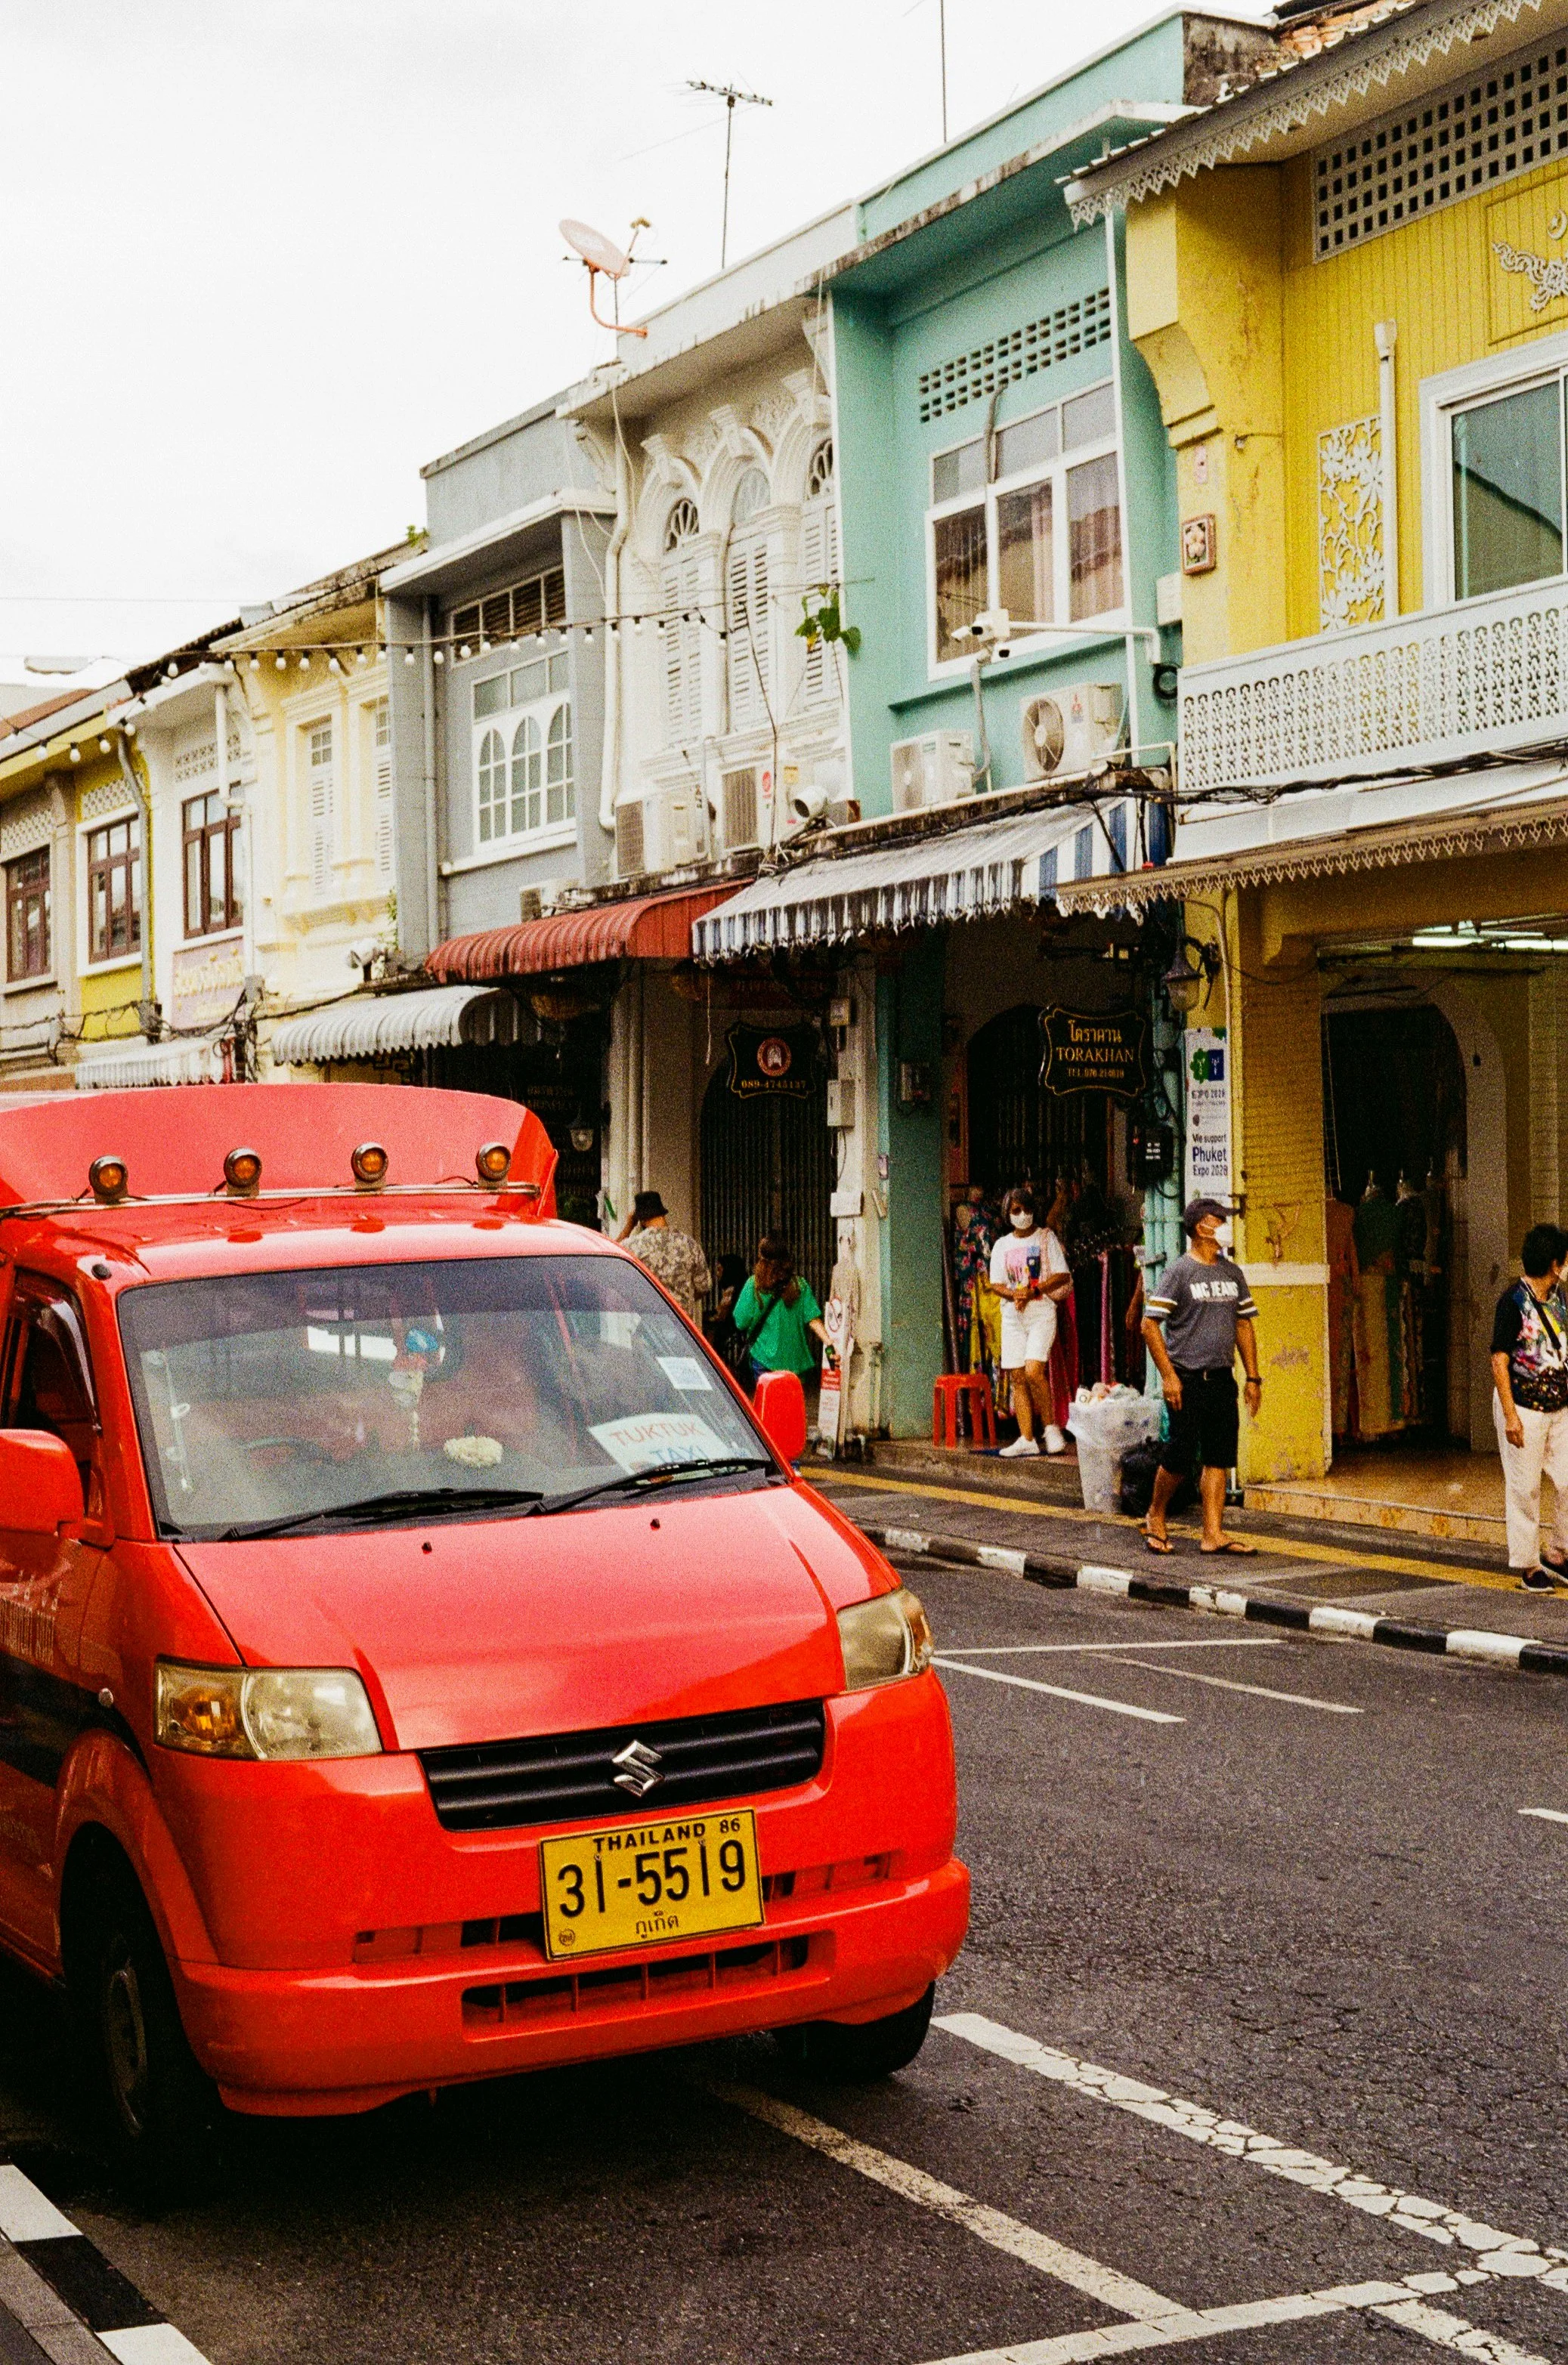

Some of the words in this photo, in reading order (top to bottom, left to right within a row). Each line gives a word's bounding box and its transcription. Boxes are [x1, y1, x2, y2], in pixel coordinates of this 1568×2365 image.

[1056, 1046, 1134, 1062] TORAKHAN
[1192, 1133, 1203, 1143] We
[1204, 1134, 1227, 1145] support
[1192, 1145, 1228, 1163] Phuket
[1192, 1164, 1210, 1177] Expo
[648, 1444, 710, 1464] TAXI
[592, 1822, 707, 1853] THAILAND
[719, 1818, 741, 1834] 86
[558, 1839, 746, 1918] 31-5519
[636, 1910, 679, 1939] ภูเก็ต
